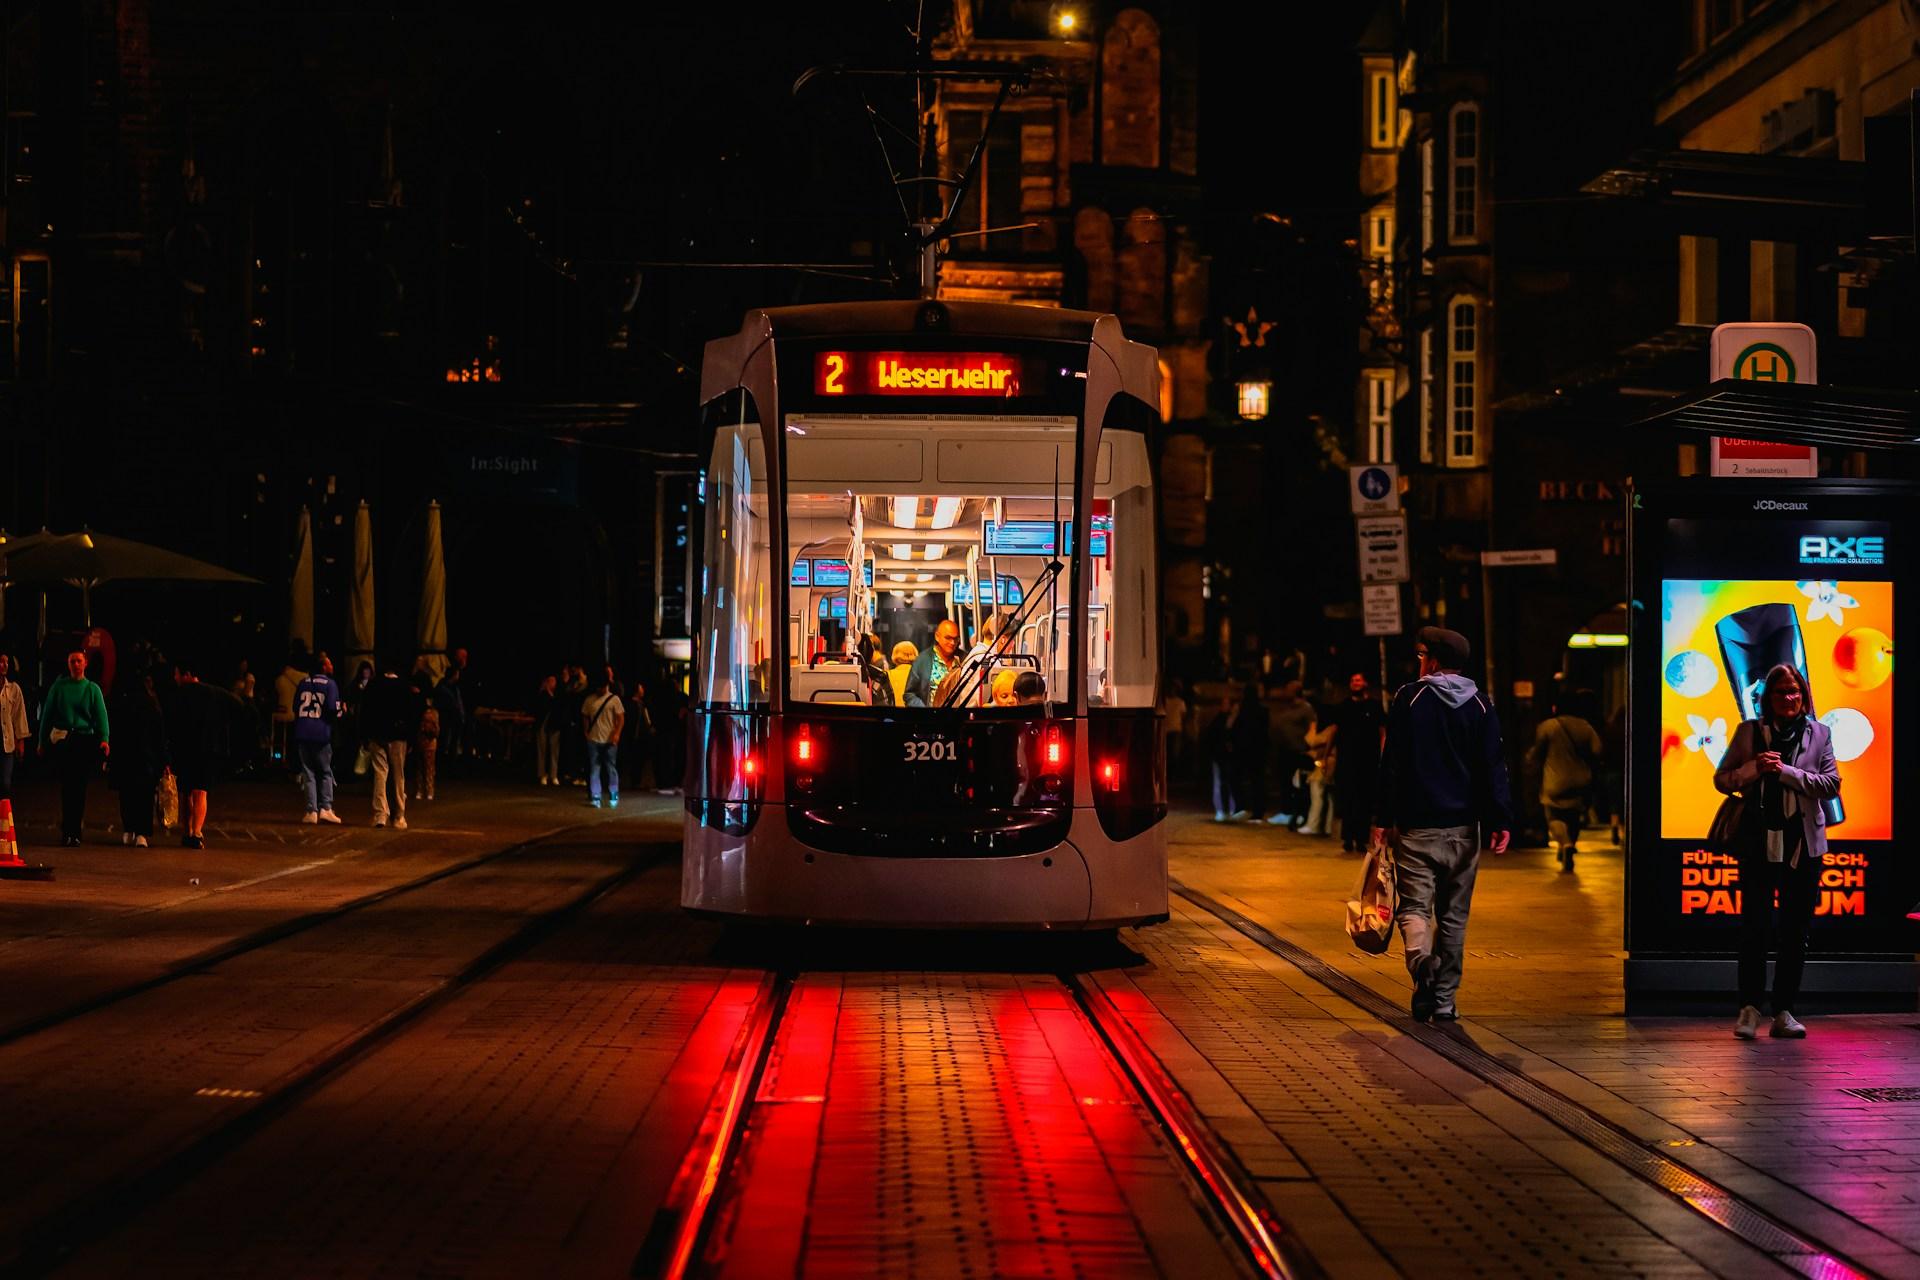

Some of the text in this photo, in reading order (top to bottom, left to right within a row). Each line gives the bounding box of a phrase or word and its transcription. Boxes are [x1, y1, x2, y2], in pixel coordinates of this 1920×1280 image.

[825, 355, 1012, 393] 2 Weserwehr
[1751, 356, 1777, 381] H
[471, 456, 537, 475] In:Sight
[1732, 463, 1739, 474] 2
[1753, 500, 1808, 511] JCDecaux
[1799, 536, 1884, 557] AXE
[903, 741, 957, 761] 3201
[1821, 853, 1869, 868] SCH,
[1682, 868, 1740, 886] DUF
